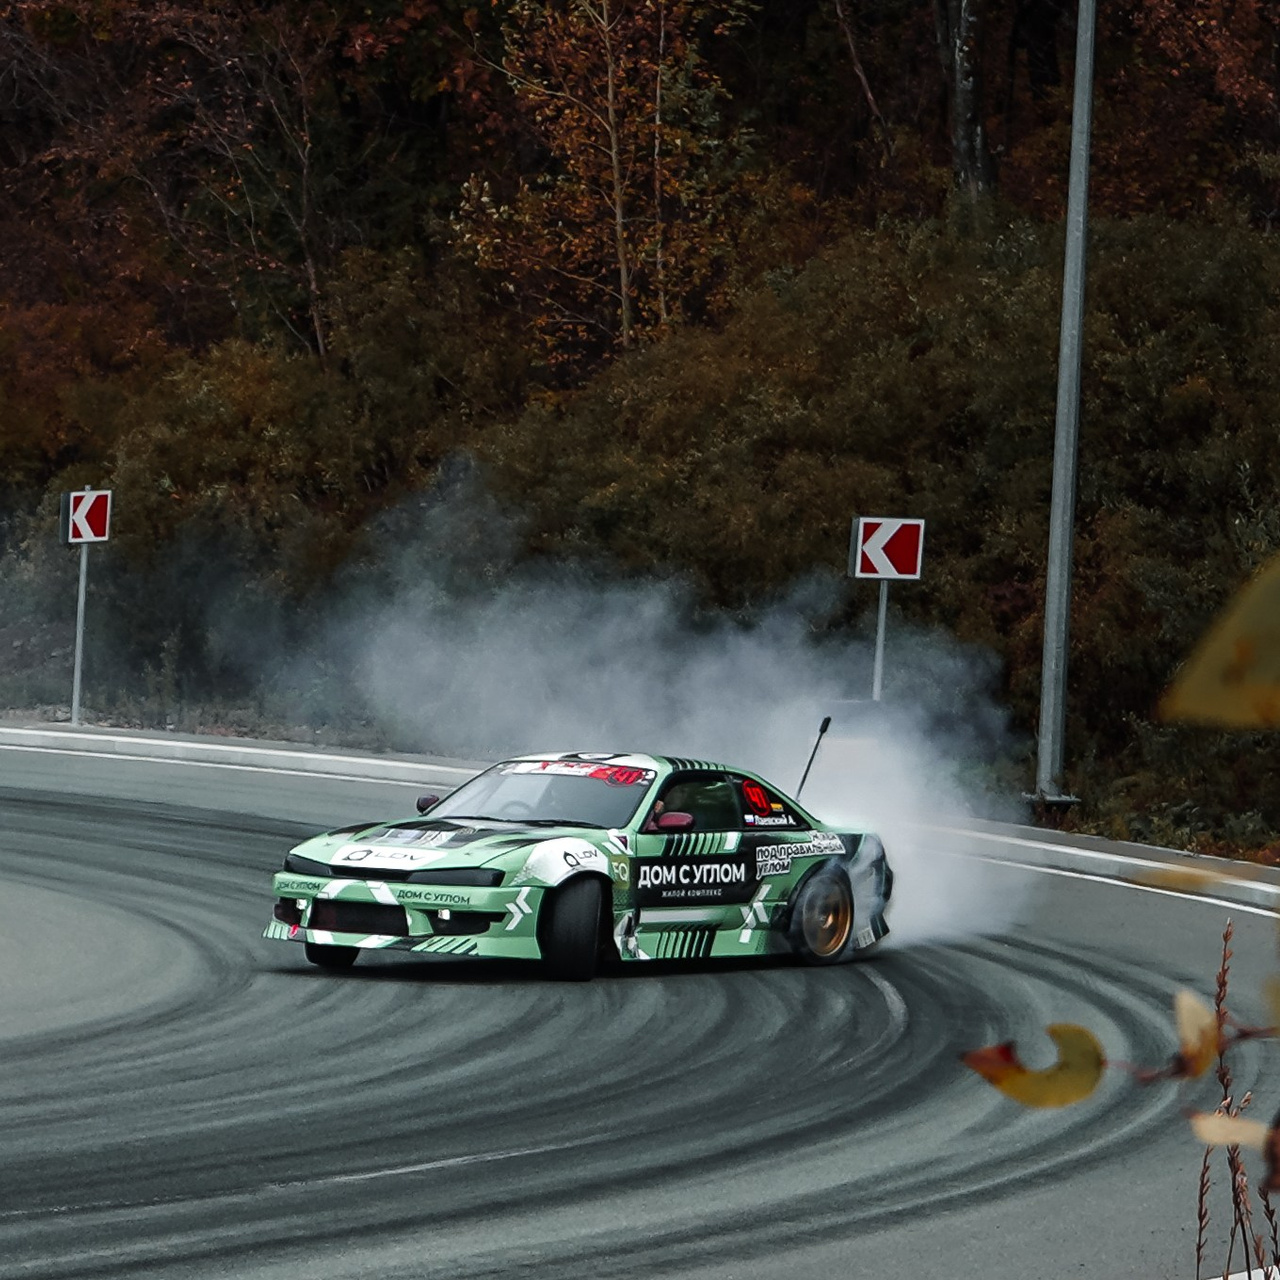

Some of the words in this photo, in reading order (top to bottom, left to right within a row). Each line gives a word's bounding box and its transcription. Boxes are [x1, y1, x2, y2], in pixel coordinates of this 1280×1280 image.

[746, 787, 767, 808] 41
[575, 849, 598, 859] LDV
[757, 846, 777, 860] под
[638, 865, 676, 889] ДОМ
[679, 865, 690, 884] С
[692, 862, 746, 884] УГЛОМ
[757, 861, 790, 878] углом
[397, 889, 422, 900] ДОМ
[424, 892, 432, 901] С
[433, 893, 470, 905] УГЛОМ
[661, 889, 686, 898] ЖИЛОЙ
[687, 888, 722, 898] КОМПЛЕКС
